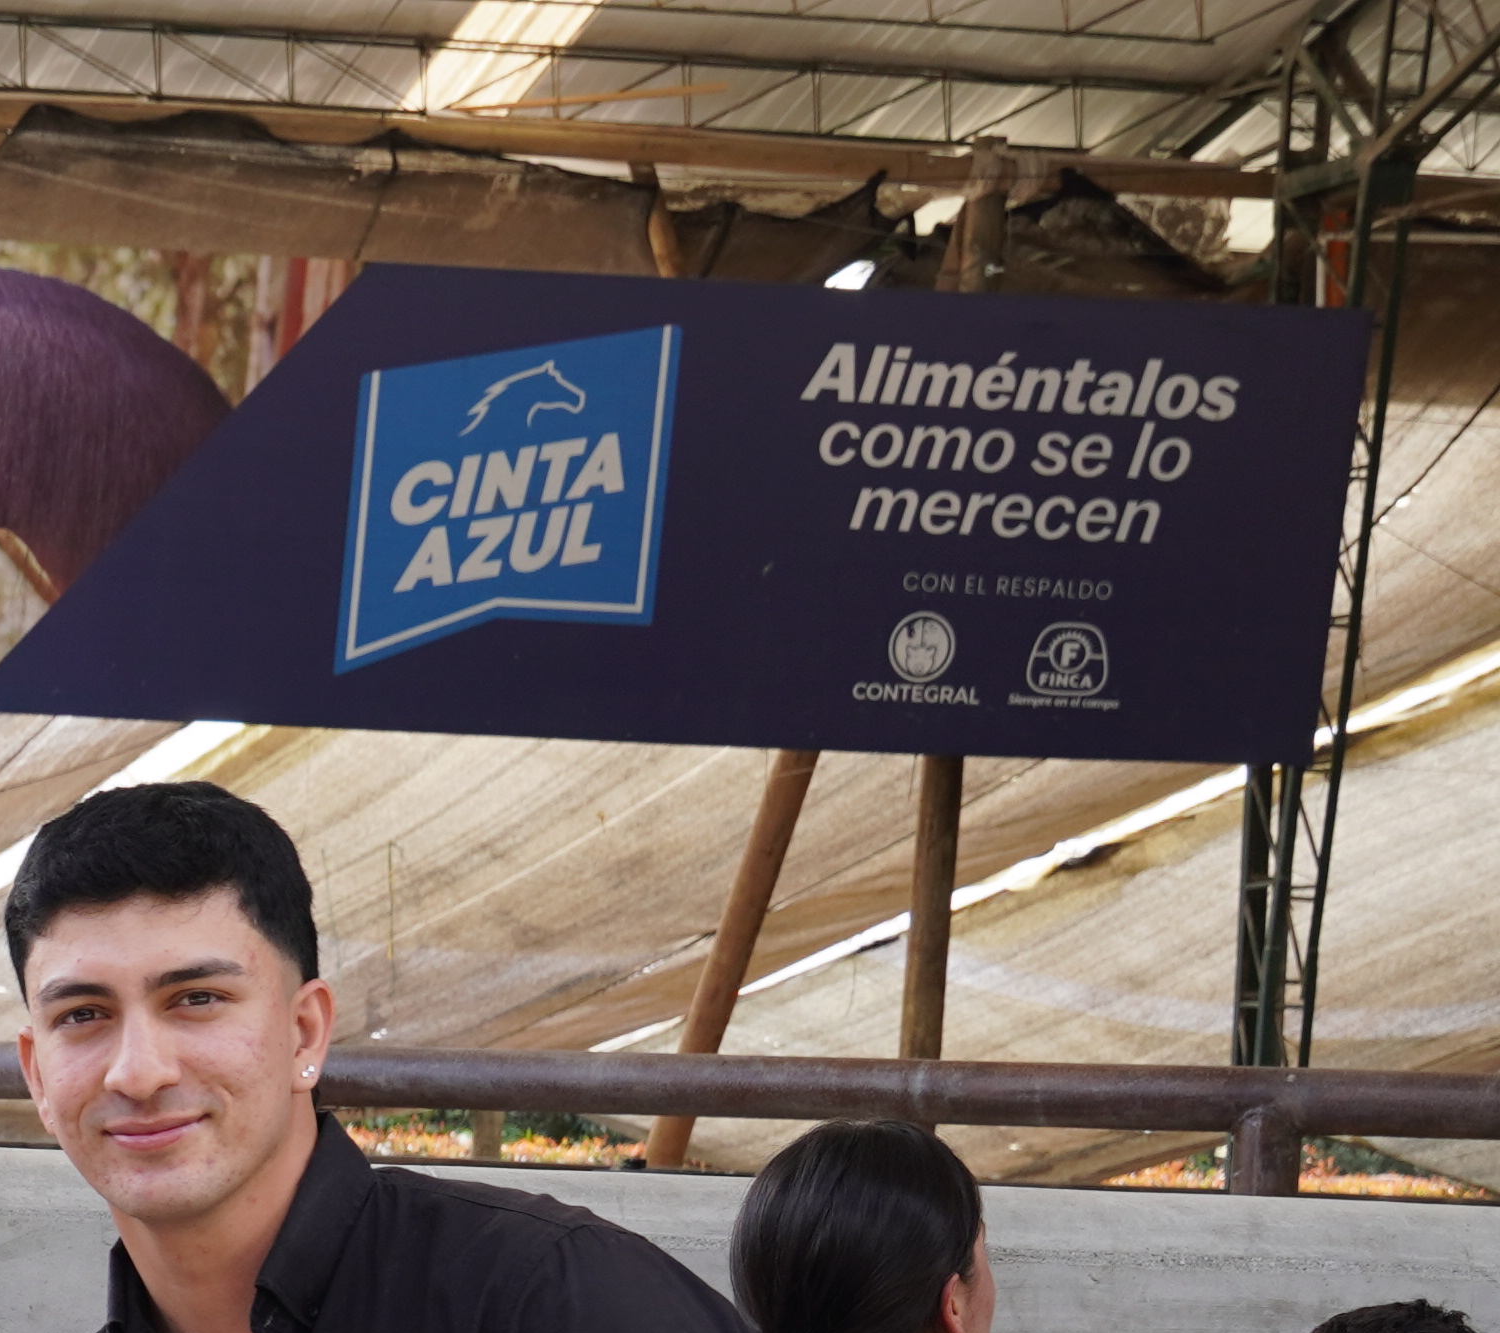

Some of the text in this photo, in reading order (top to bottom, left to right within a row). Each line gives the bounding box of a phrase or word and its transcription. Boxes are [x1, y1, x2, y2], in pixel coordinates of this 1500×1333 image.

[800, 342, 1241, 422] Aliméntalos
[390, 432, 625, 526] CINTA
[818, 421, 1193, 483] como se lo
[849, 486, 1162, 544] merecen
[393, 502, 602, 593] AZUL
[903, 571, 1114, 601] CON EL RESPALDO
[852, 681, 981, 706] CONTEGRAL
[1038, 672, 1093, 689] FINCA
